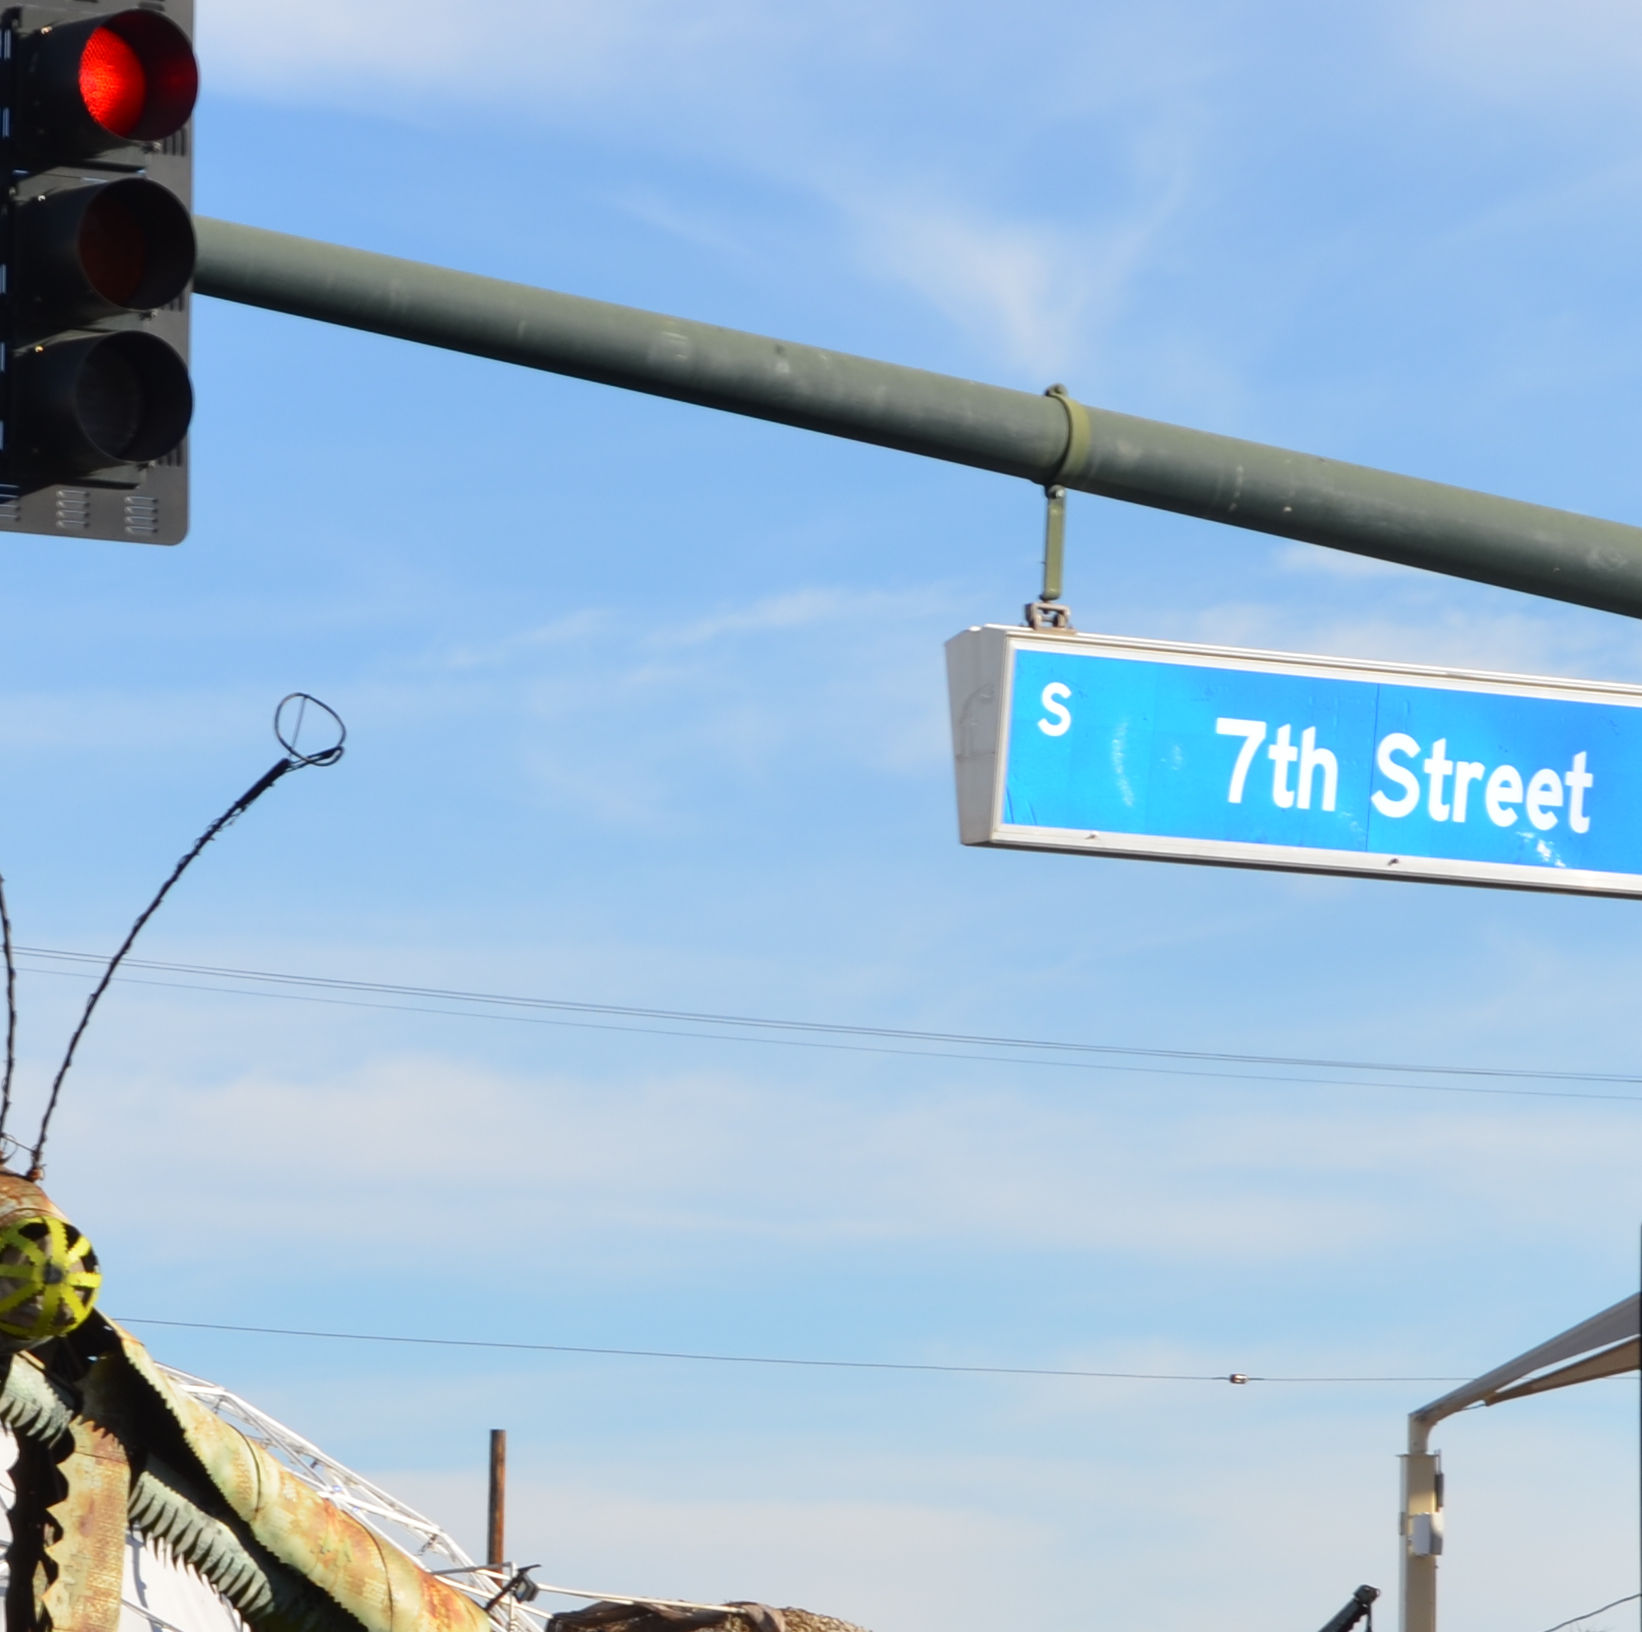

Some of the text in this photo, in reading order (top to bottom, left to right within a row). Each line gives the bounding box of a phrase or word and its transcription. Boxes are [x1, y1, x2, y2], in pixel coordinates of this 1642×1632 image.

[1036, 681, 1073, 738] S
[1215, 716, 1339, 813] 7th
[1369, 730, 1594, 835] Street
